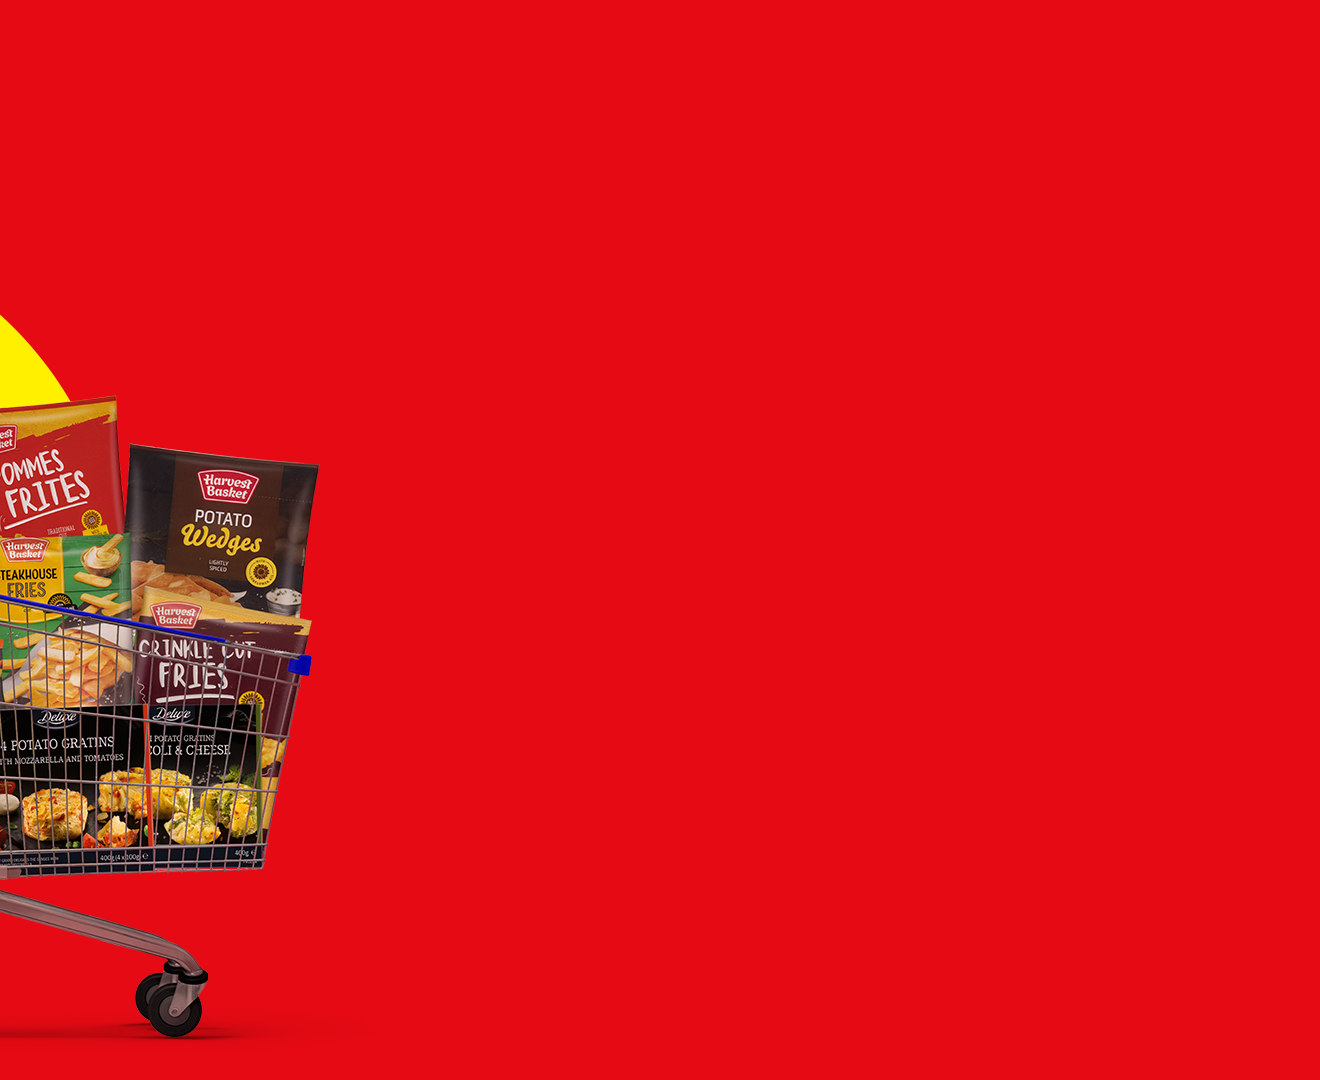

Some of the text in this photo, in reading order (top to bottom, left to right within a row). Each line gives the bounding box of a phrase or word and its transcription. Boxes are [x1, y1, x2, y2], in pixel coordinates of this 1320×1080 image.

[203, 473, 253, 490] Harvest
[4, 470, 91, 518] FRITES
[206, 485, 248, 500] Basket
[195, 508, 253, 528] POTATO
[47, 525, 75, 535] TRADITIONAL
[6, 541, 44, 551] Harvest
[181, 523, 262, 556] Wedges
[9, 550, 42, 559] Basket
[208, 559, 229, 567] LIGHTLY
[209, 565, 227, 573] SPICED
[7, 582, 46, 598] FRIES
[156, 606, 196, 617] Harvest
[158, 615, 194, 626] Basket
[138, 638, 214, 659] CRINKLE
[158, 661, 229, 690] FRIES
[37, 710, 77, 725] Deluxe
[152, 707, 191, 721] Deluxe
[0, 736, 115, 751] 4 POTATO GRATINS
[183, 734, 215, 742] GRATINS
[175, 744, 183, 756] &
[186, 744, 231, 756] CHEESE
[14, 755, 64, 765] MOZZARELLA
[66, 754, 81, 763] AND
[84, 753, 124, 762] TOMATOES
